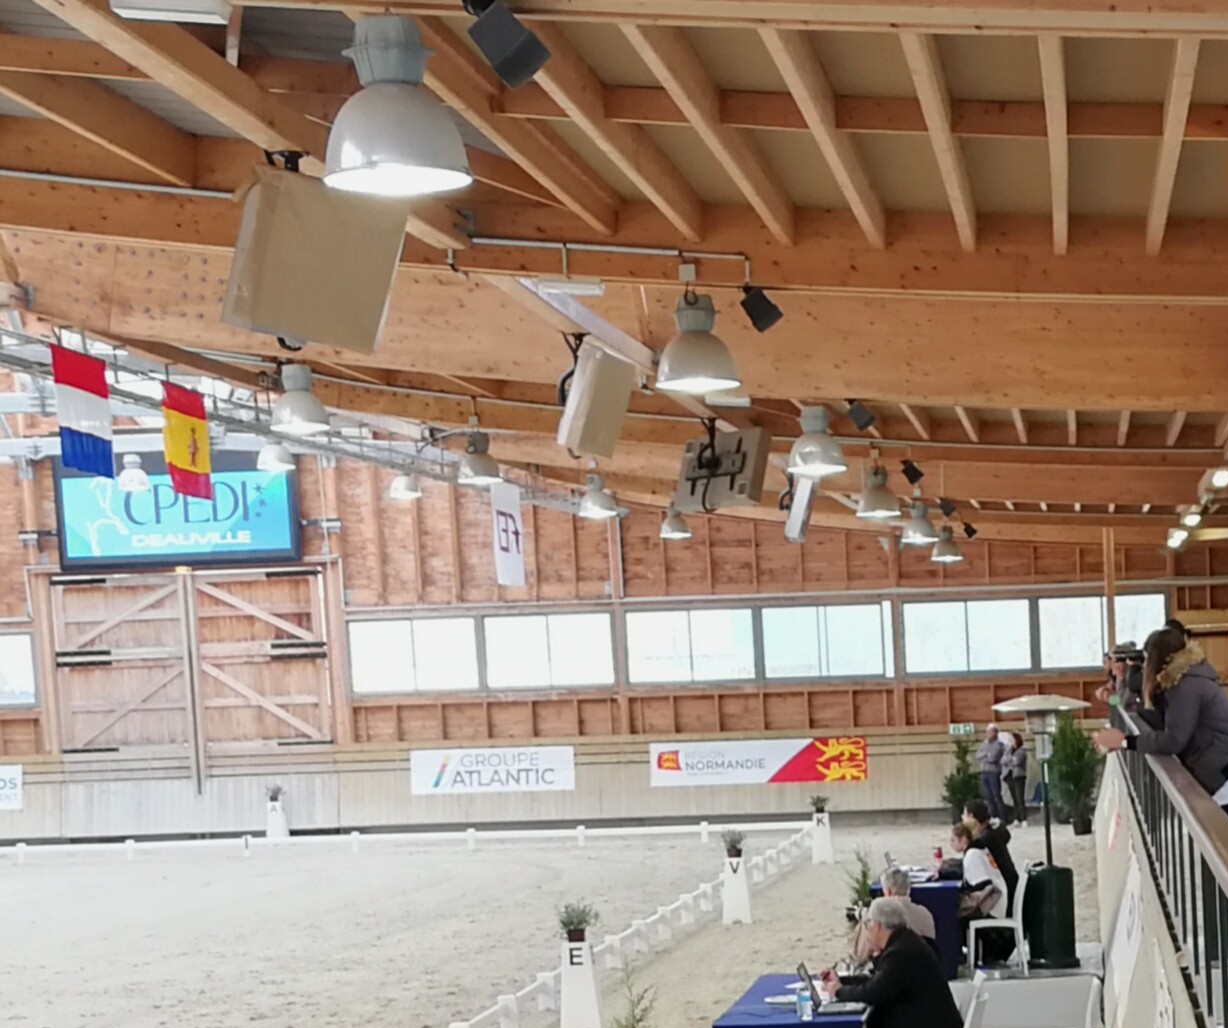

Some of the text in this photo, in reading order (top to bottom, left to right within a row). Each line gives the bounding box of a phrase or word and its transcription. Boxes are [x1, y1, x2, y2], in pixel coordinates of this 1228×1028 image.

[130, 530, 252, 547] DEAUVILLE
[460, 752, 540, 768] GROUPE
[685, 758, 766, 772] NORMANDIE
[451, 768, 556, 788] ATLANTIC
[816, 815, 826, 826] K
[729, 861, 740, 874] V
[569, 947, 584, 966] E
